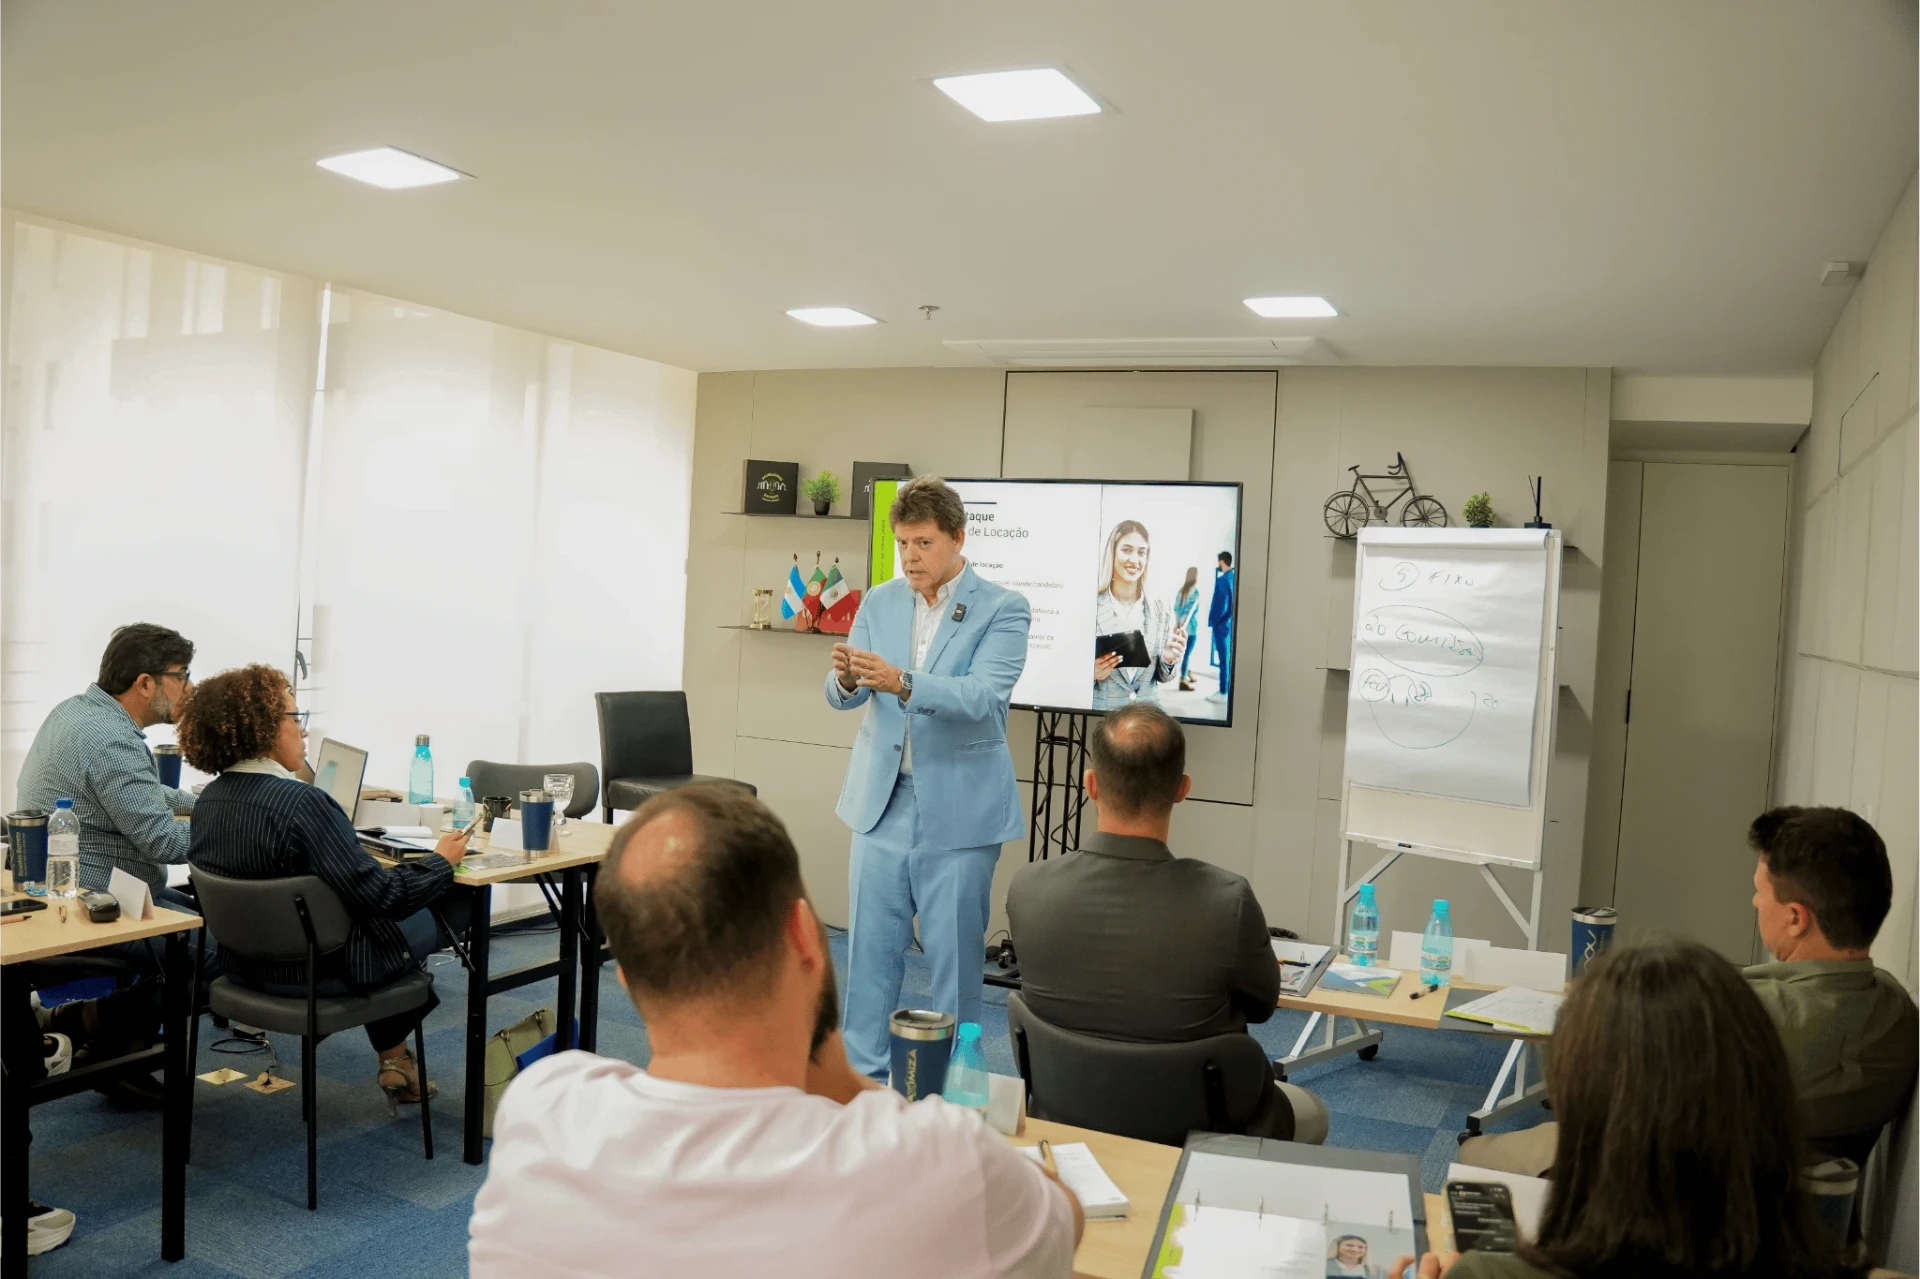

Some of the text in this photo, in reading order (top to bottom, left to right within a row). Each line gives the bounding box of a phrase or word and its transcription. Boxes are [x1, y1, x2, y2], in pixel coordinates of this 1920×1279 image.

[966, 512, 995, 523] aque
[968, 526, 1029, 540] de Locação
